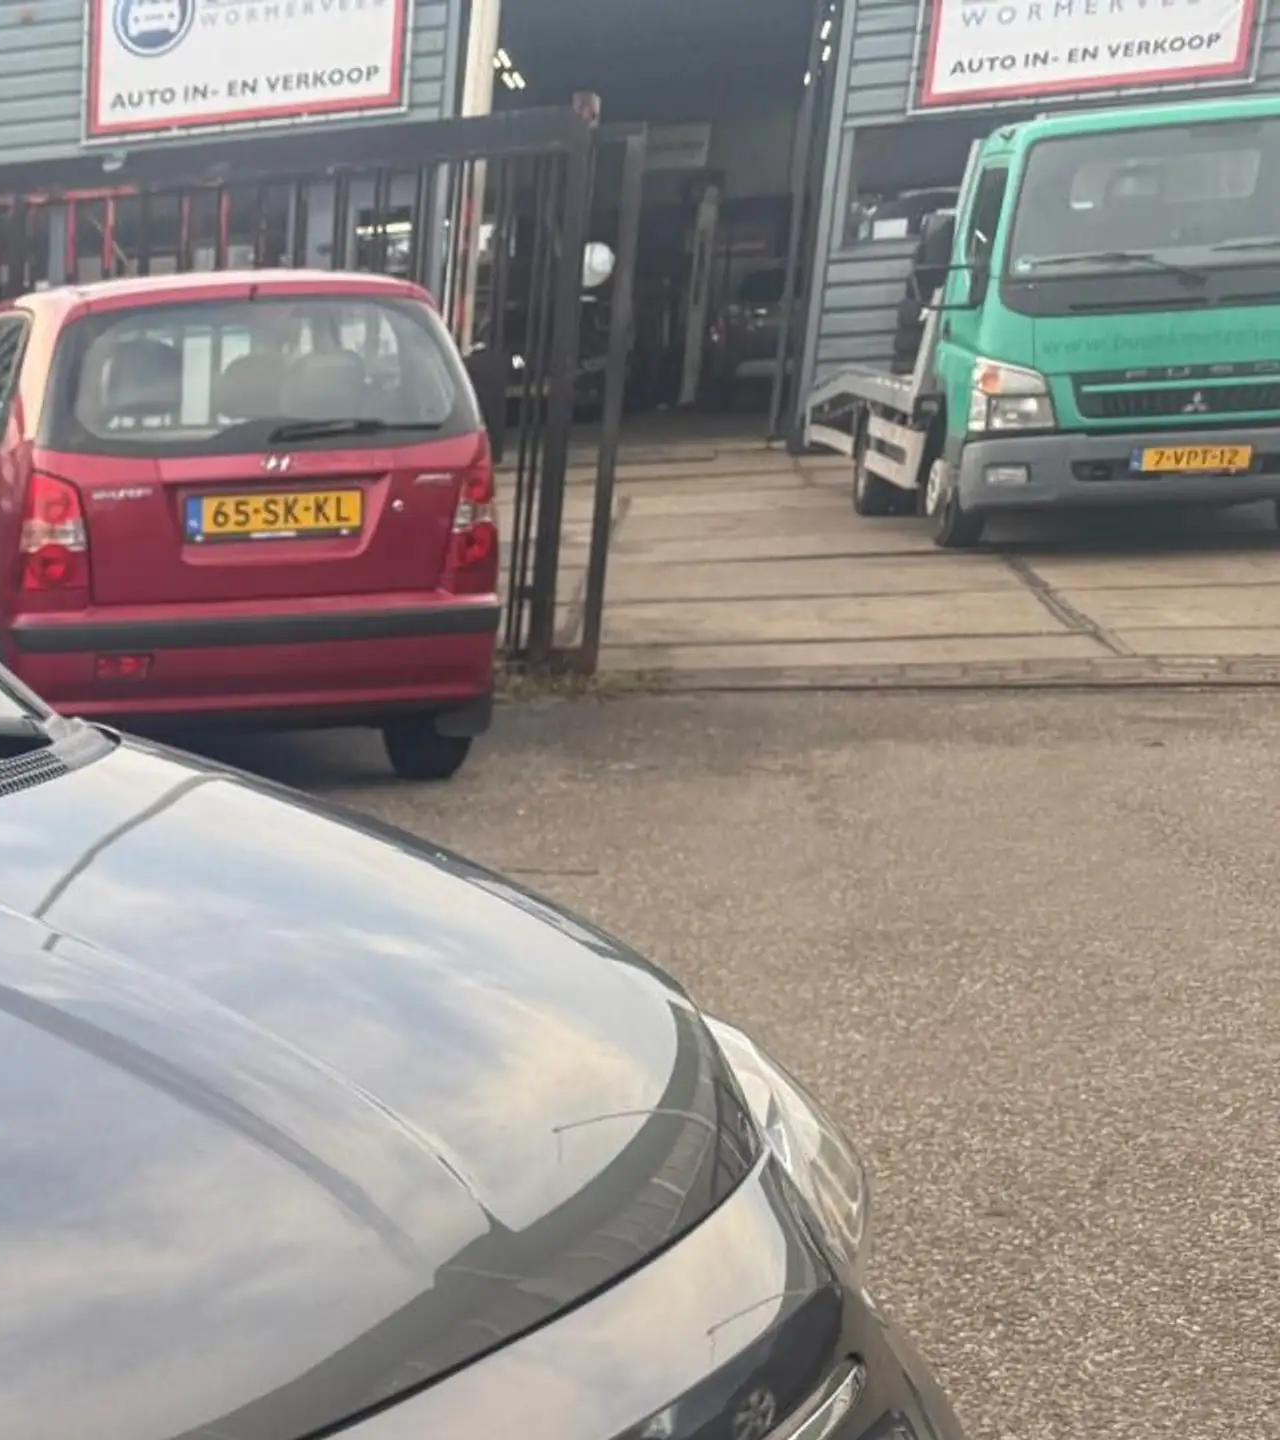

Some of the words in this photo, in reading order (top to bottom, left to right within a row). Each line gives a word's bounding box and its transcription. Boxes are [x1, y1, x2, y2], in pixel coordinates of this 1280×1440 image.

[950, 55, 1017, 76] AUTO
[1024, 50, 1058, 69] IN-
[1067, 45, 1098, 64] EN
[1106, 32, 1222, 59] VERKOOP
[110, 87, 176, 110] AUTO
[184, 83, 219, 101] IN-
[226, 78, 258, 97] EN
[265, 64, 381, 93] VERKOOP
[211, 496, 352, 528] 65-SK-KL
